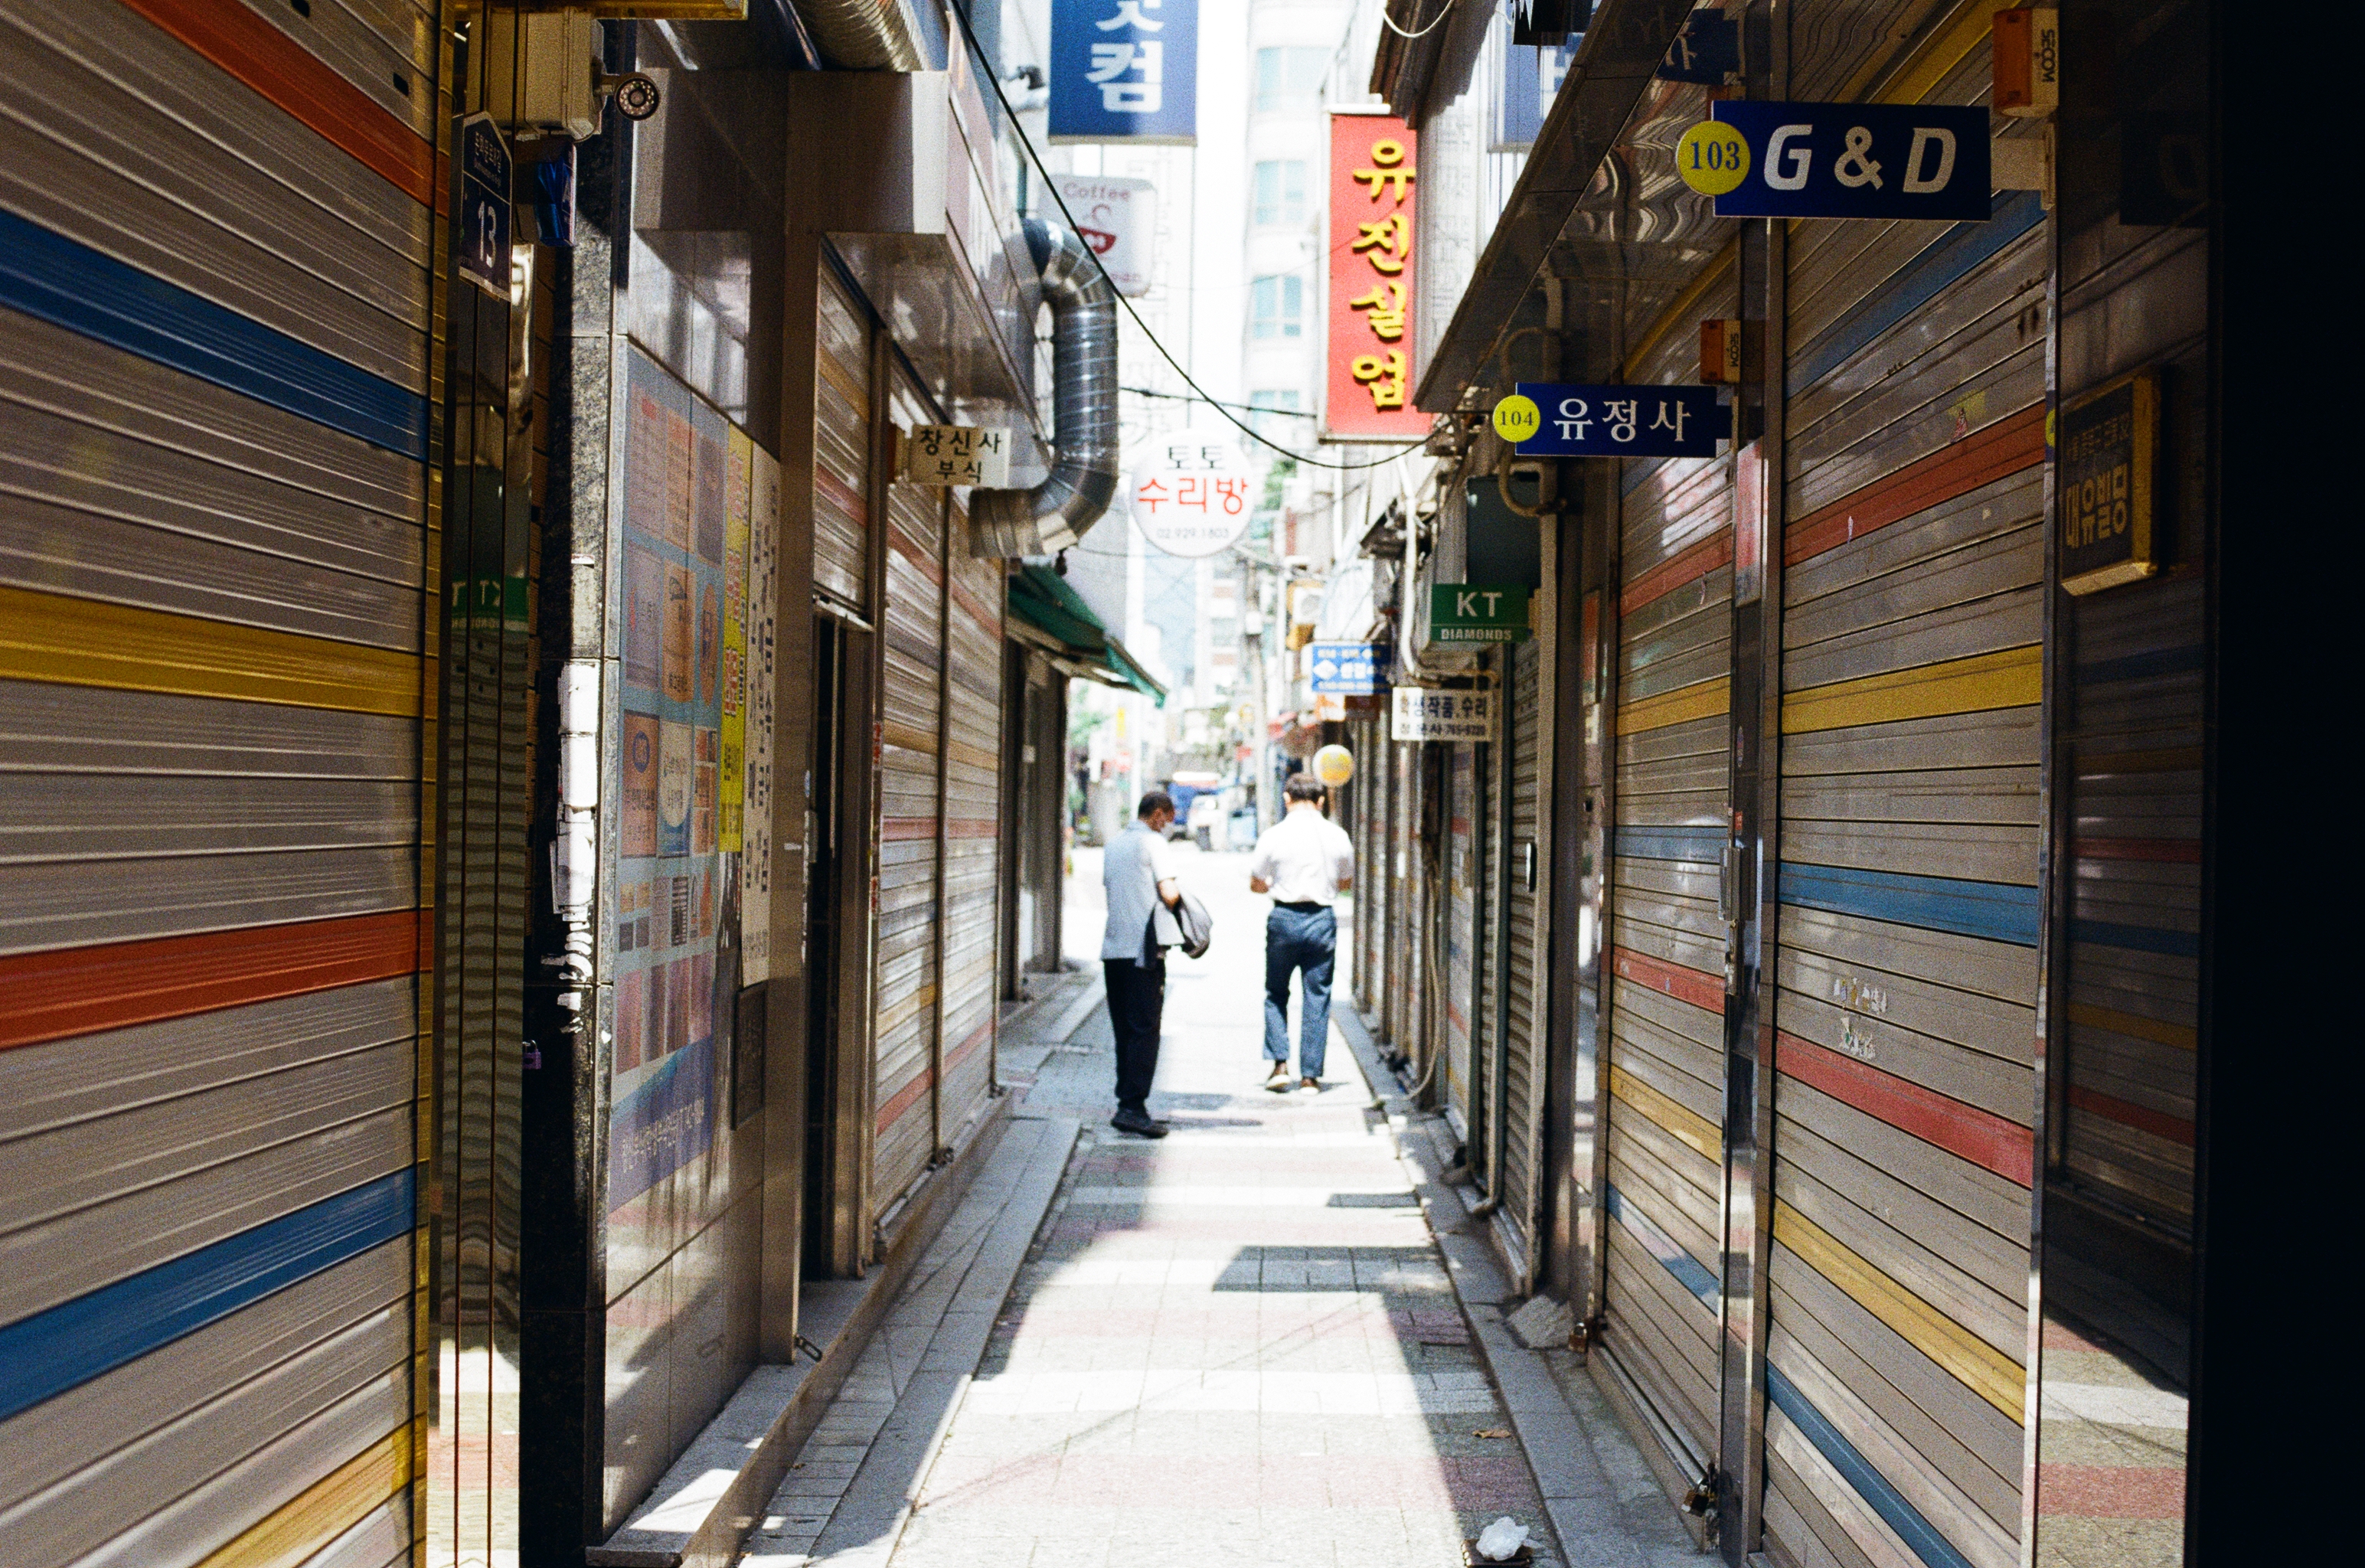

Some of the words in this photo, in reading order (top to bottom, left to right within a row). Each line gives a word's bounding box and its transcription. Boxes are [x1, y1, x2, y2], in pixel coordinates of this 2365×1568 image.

[2041, 28, 2056, 83] SECOM
[1690, 140, 1740, 170] 103
[1763, 124, 1814, 191] G
[1834, 126, 1884, 191] &
[1903, 127, 1957, 194] D
[1063, 182, 1132, 201] Coffee
[478, 200, 497, 268] 13
[1350, 139, 1416, 410] 유진실업
[1730, 332, 1739, 368] SECOM
[1499, 410, 1534, 426] 104
[1553, 398, 1692, 443] 유정사
[919, 429, 1001, 456] 창신사
[1165, 446, 1225, 470] 토토
[935, 459, 983, 483] 부식
[1137, 476, 1249, 516] 수리방
[2066, 462, 2128, 550] 대유빌딩
[1457, 591, 1503, 618] KT
[1440, 628, 1512, 642] DIAMONDS
